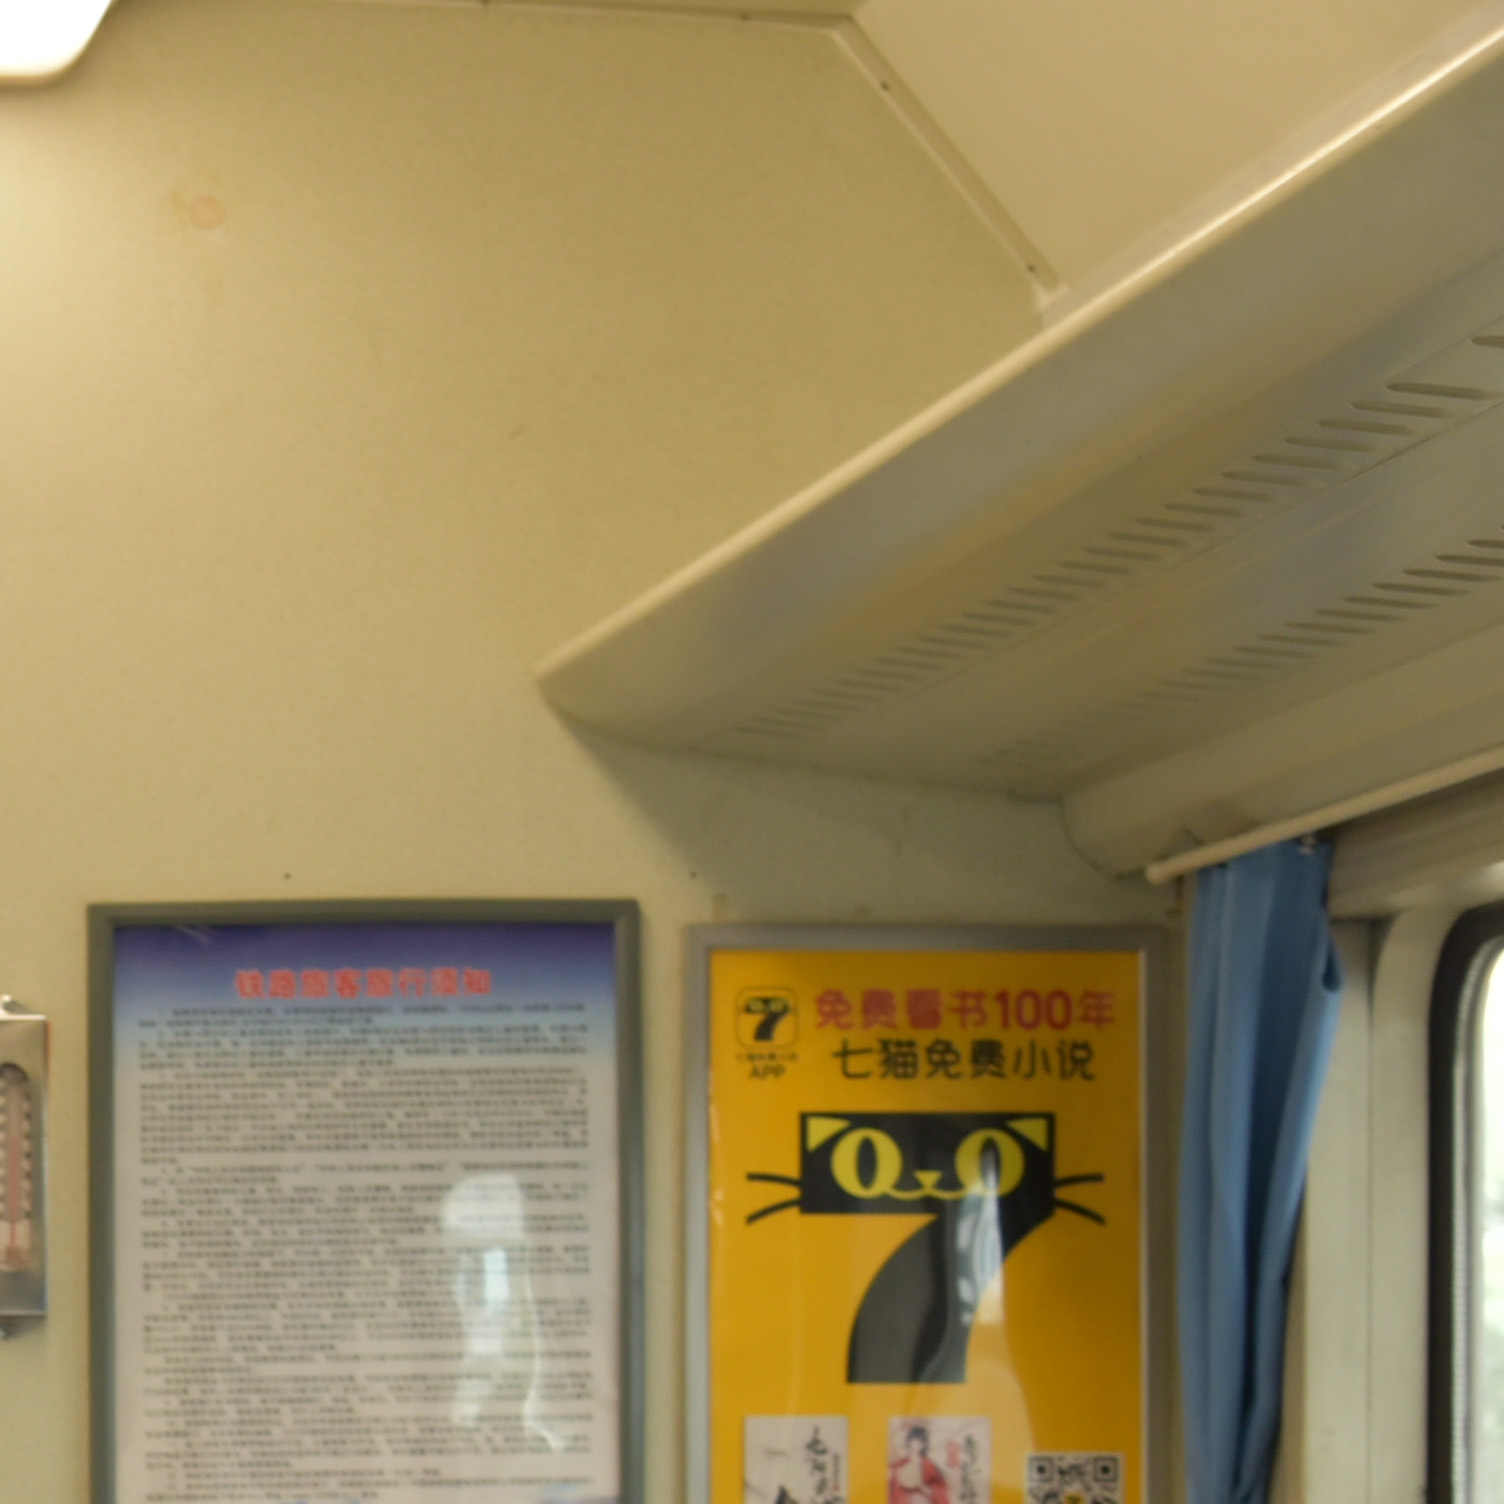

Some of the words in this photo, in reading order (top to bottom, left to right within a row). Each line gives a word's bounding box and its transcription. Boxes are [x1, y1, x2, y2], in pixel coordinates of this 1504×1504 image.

[815, 988, 1116, 1032] 免费看书100年
[832, 1038, 1097, 1082] 七猫免费小说
